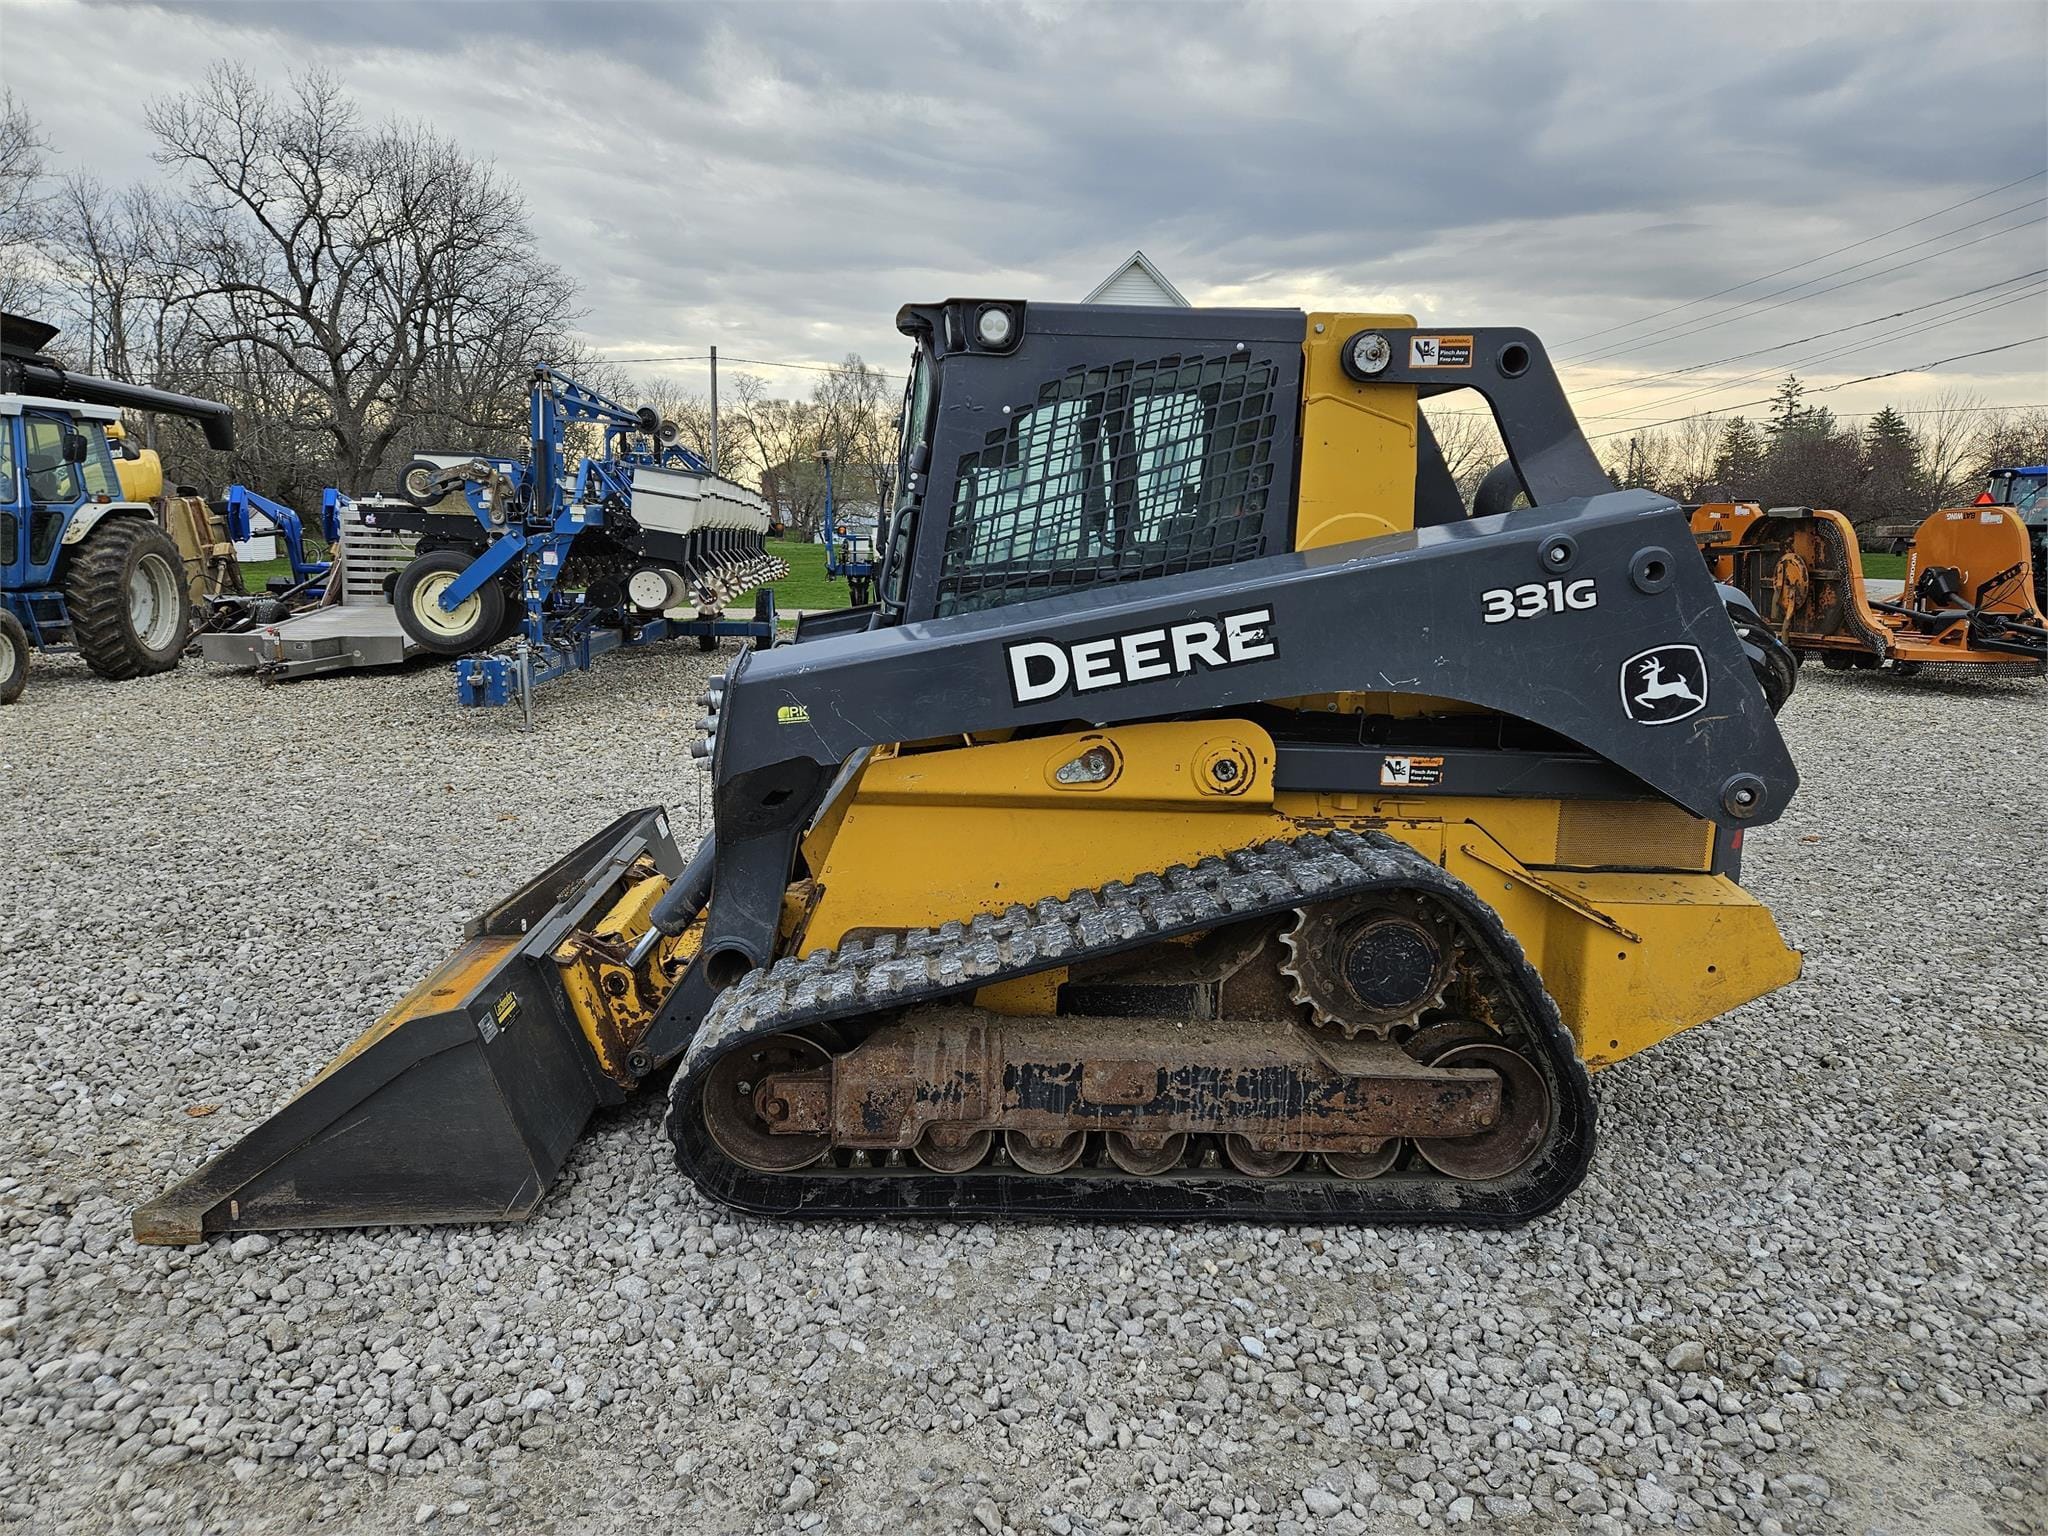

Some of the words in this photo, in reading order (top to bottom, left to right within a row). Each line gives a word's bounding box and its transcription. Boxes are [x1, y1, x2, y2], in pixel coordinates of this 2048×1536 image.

[1909, 552, 1917, 584] WOODS
[1482, 579, 1597, 623] 331G
[1009, 609, 1275, 702] DEERE
